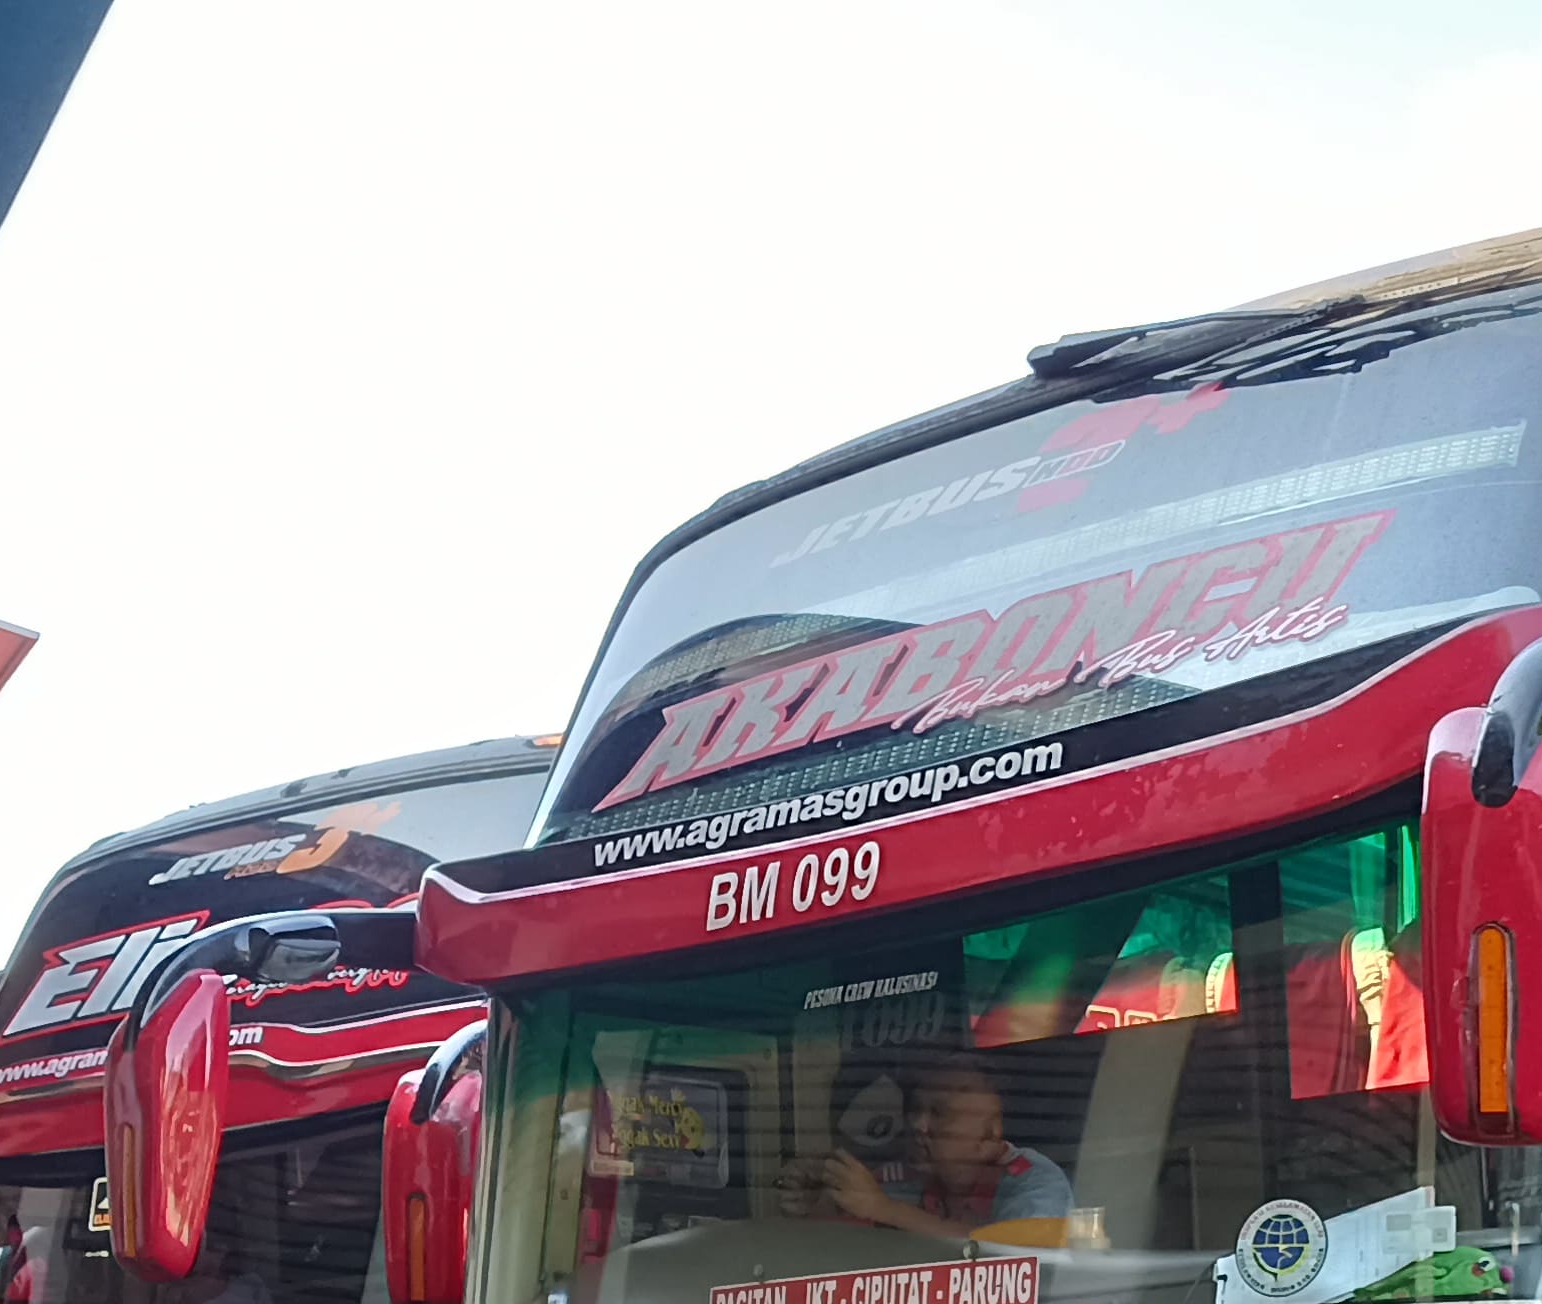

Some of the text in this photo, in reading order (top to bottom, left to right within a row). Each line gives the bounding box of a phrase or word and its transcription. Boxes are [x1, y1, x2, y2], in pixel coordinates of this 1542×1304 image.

[769, 456, 1042, 568] JETBUS
[1081, 629, 1197, 690] Bus
[593, 742, 1063, 868] www.agramasgroup.com
[148, 833, 307, 886] JETBUS
[706, 840, 880, 931] BM 099
[844, 980, 876, 1003] CREW
